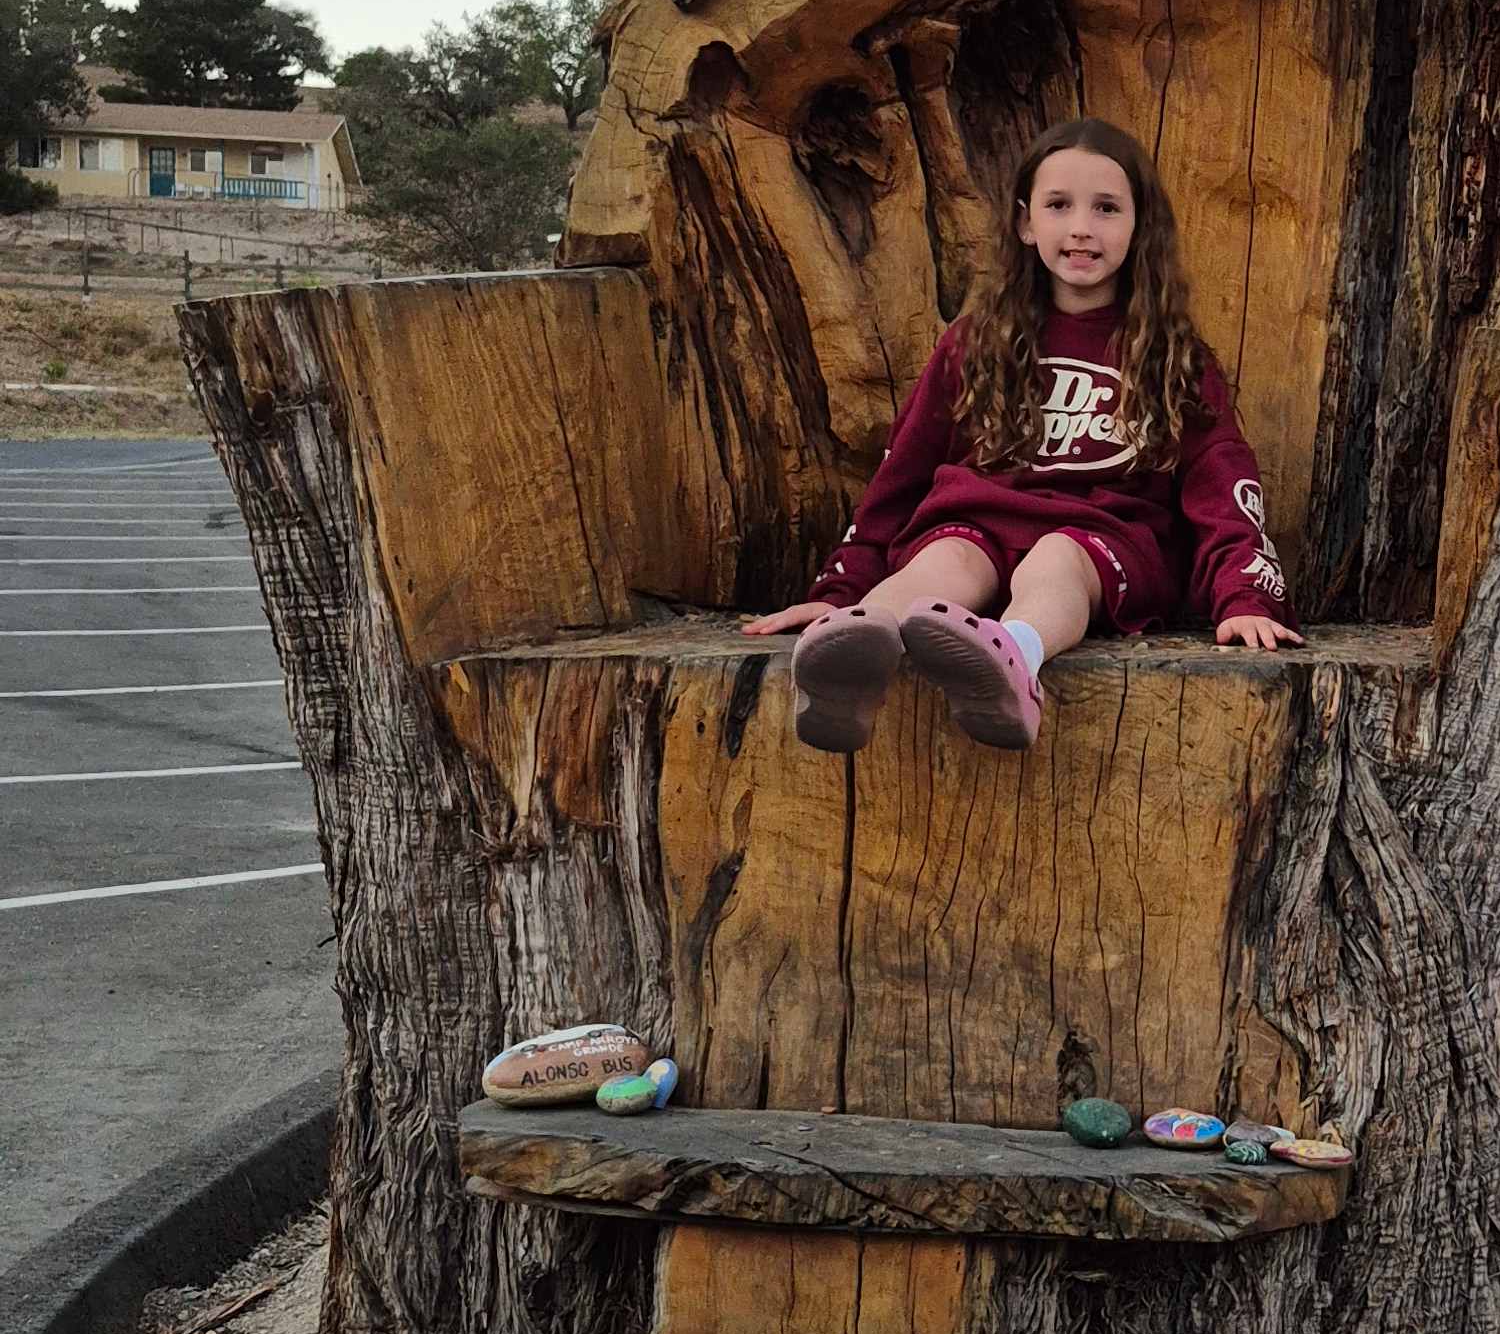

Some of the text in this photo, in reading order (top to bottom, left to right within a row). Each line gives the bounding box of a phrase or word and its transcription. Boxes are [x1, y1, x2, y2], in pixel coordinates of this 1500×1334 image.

[1040, 368, 1114, 413] Dr
[548, 1038, 585, 1052] CAMP
[590, 1034, 639, 1046] ARROYO
[573, 1043, 625, 1057] GRANDE
[520, 1056, 633, 1086] ALONSO BUS
